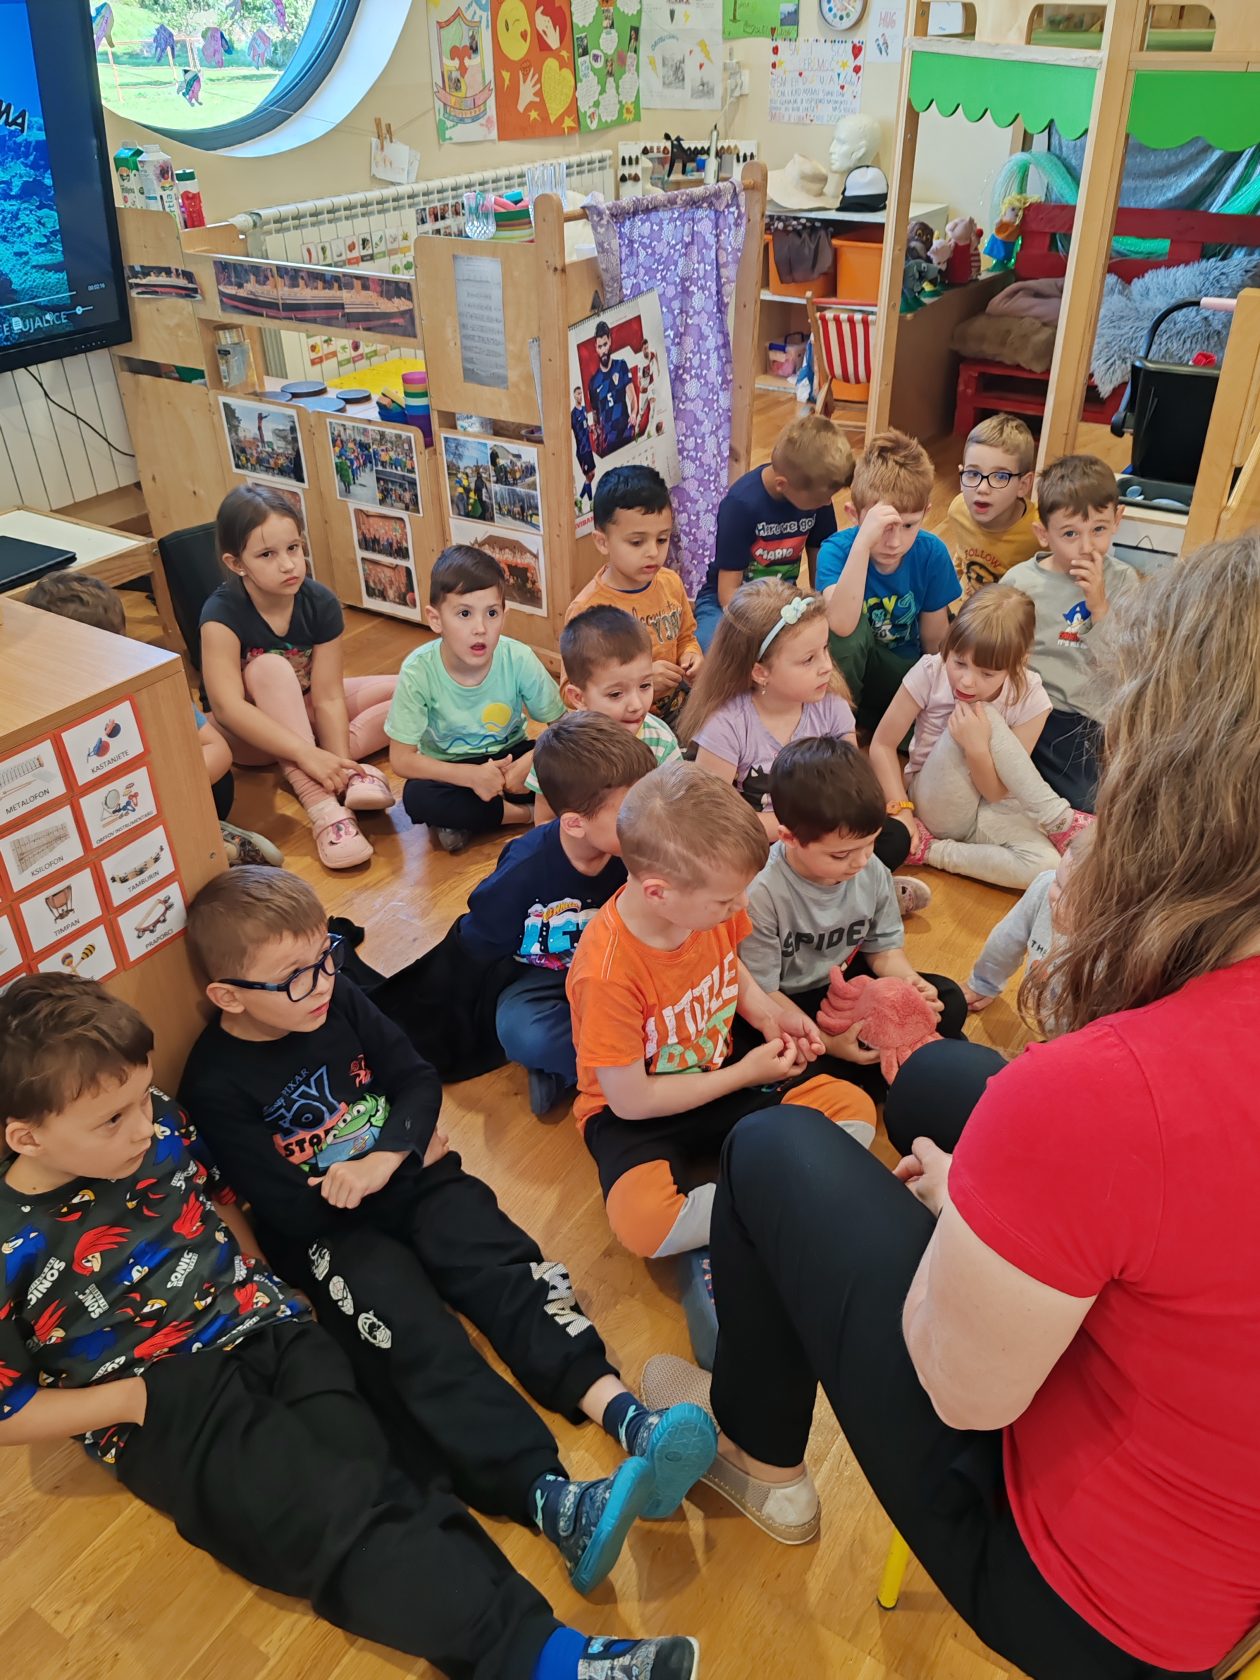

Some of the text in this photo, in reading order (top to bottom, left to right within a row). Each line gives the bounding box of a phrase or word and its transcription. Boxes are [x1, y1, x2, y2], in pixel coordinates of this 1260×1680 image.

[755, 547, 794, 561] MARIO
[964, 548, 1001, 569] FOLLOW
[91, 750, 129, 774] KASTANJETE
[5, 788, 51, 815] METALOFON
[31, 855, 64, 877] KSILOFON
[127, 870, 160, 893] TAMBURIN
[54, 918, 81, 937] TIMPAN
[145, 928, 174, 950] PRAPORCI
[782, 917, 874, 958] SPIDE
[281, 1067, 310, 1097] PIXAR
[263, 1064, 341, 1142] TOY
[166, 1250, 193, 1290] SONIC
[27, 1259, 66, 1306] SONIC
